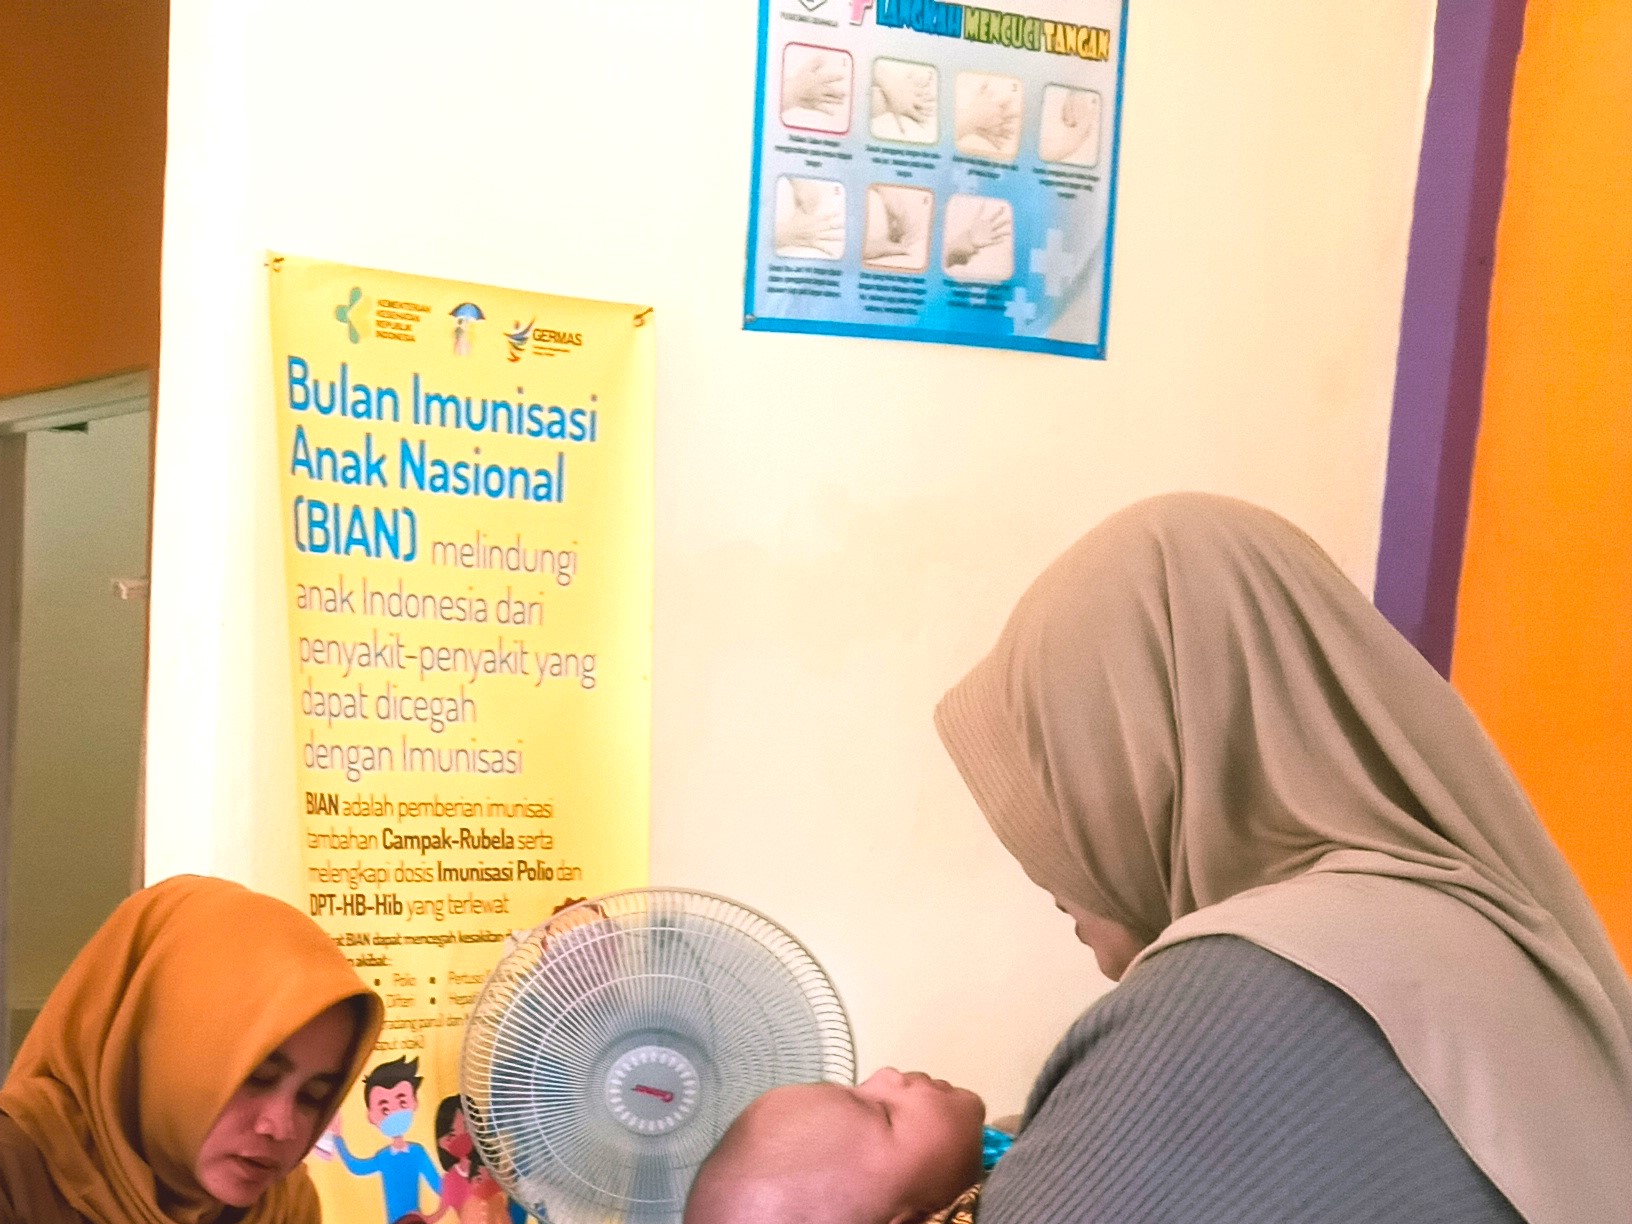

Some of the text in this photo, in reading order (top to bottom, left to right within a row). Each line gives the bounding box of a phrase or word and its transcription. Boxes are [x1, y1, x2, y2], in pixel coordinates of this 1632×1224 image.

[963, 6, 1042, 51] MENCUCI
[1042, 20, 1111, 61] TANGAN
[532, 328, 583, 346] GERMAS
[286, 355, 598, 442] Bulan Imunisasi
[291, 425, 565, 503] Anak Nasional
[294, 495, 578, 586] (BIAN) melindungi
[296, 574, 545, 626] anak Indonesia dari
[299, 629, 597, 689] penyakit-penyakit yang
[301, 677, 477, 733] dapat dicegah
[304, 730, 523, 783] dengan Imunisasi
[305, 791, 555, 824] BIAN adalah pemberian imunisasi
[307, 825, 554, 855] tambahan Campak-Rubela serta
[308, 859, 583, 890] melengkapi dosis Imunisasi Polio dan
[309, 893, 510, 922] DPT-HB-Hib yang terlewat
